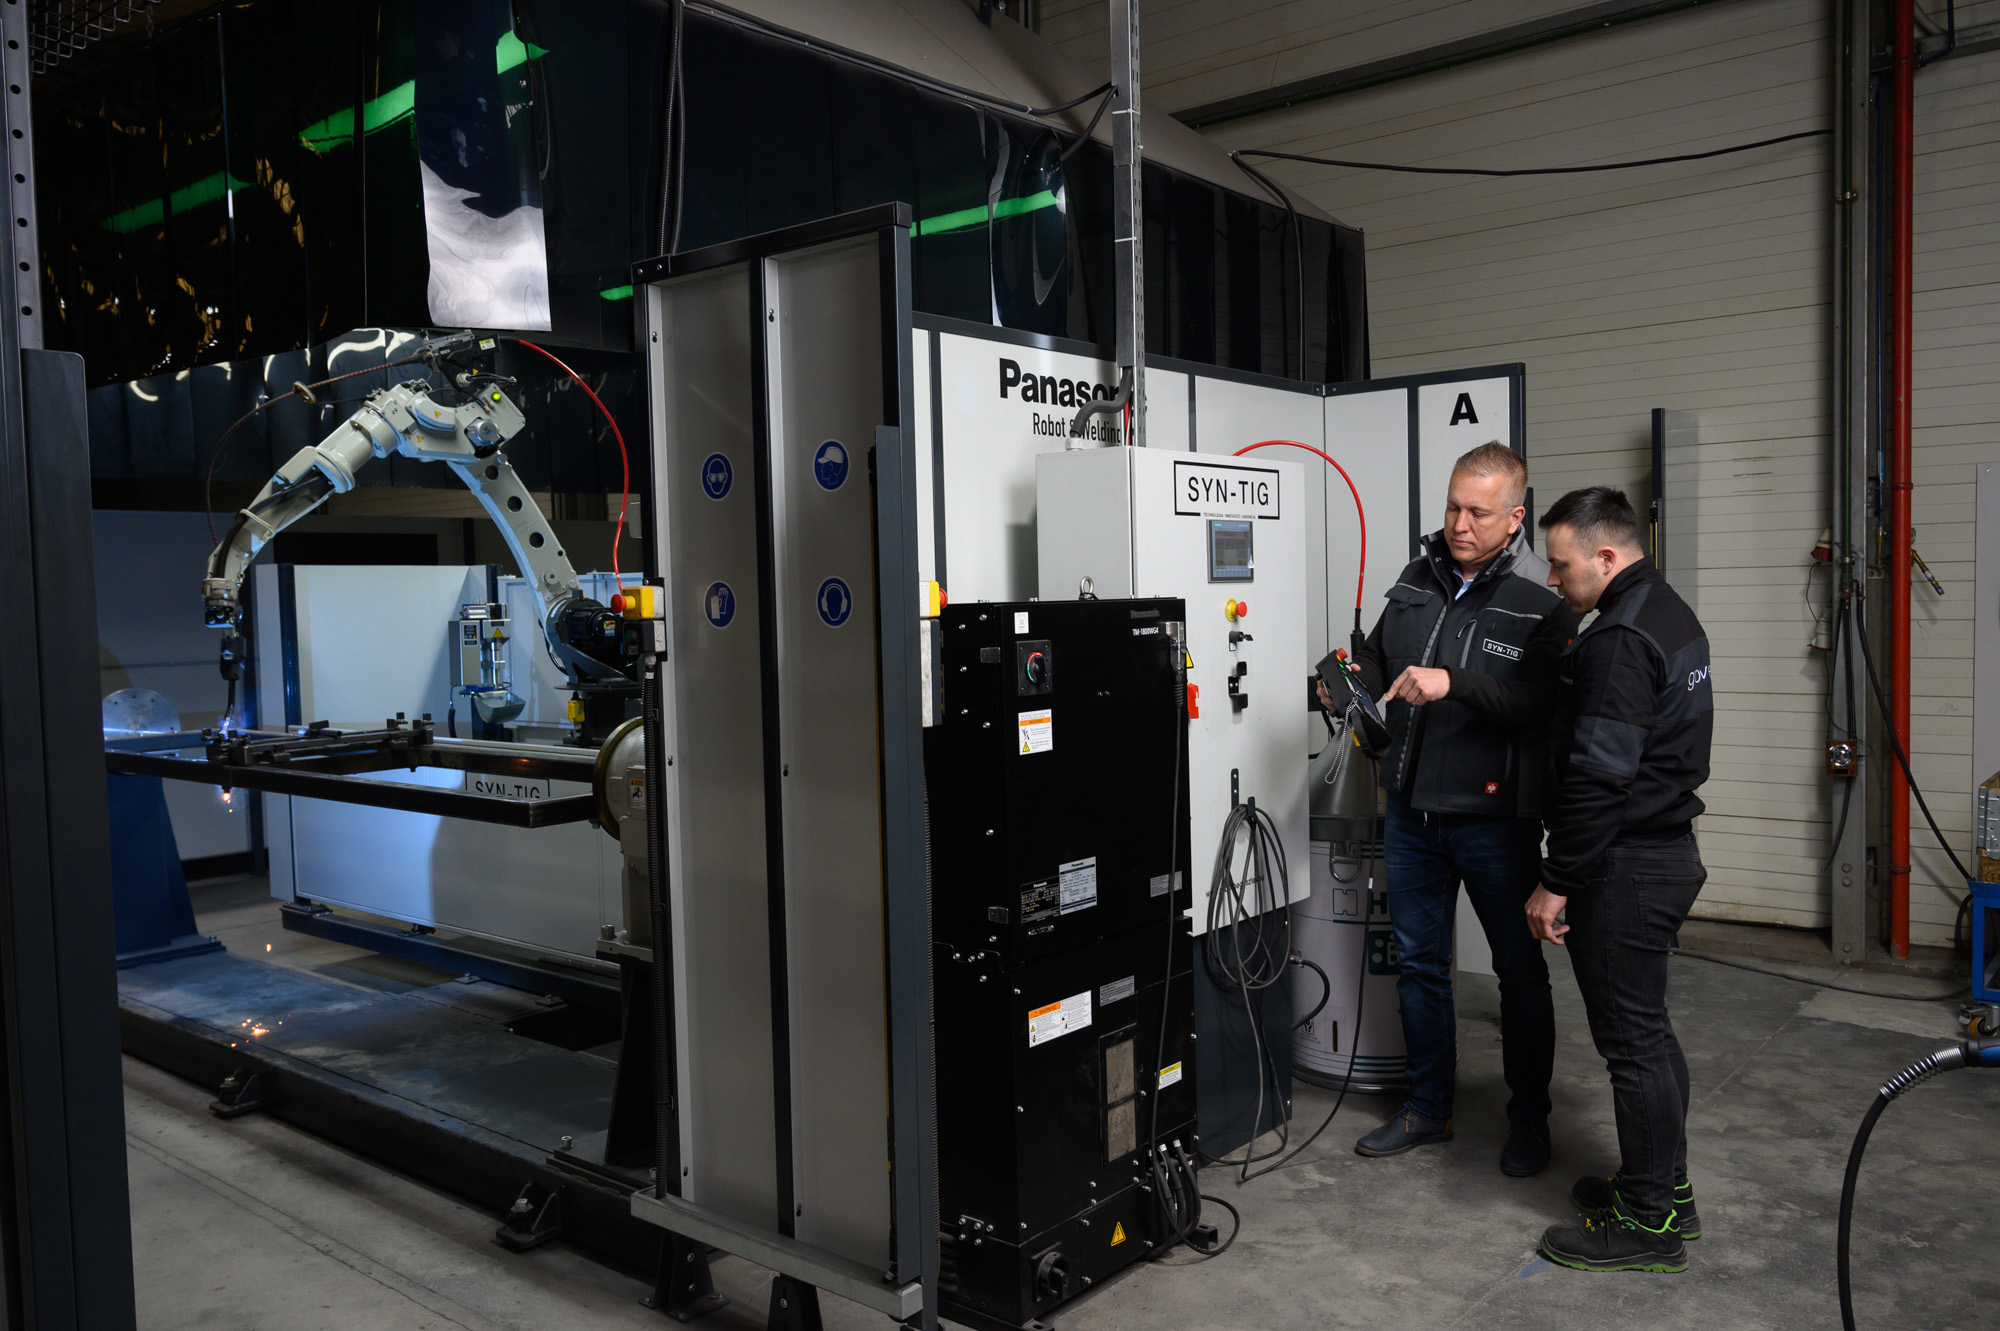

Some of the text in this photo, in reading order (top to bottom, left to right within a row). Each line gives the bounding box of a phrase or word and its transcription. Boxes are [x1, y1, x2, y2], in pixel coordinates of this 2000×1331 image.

[1449, 392, 1479, 426] A
[1032, 412, 1066, 438] Robot
[1188, 476, 1269, 506] SYN-TIG
[1487, 642, 1519, 658] SYN-TIG
